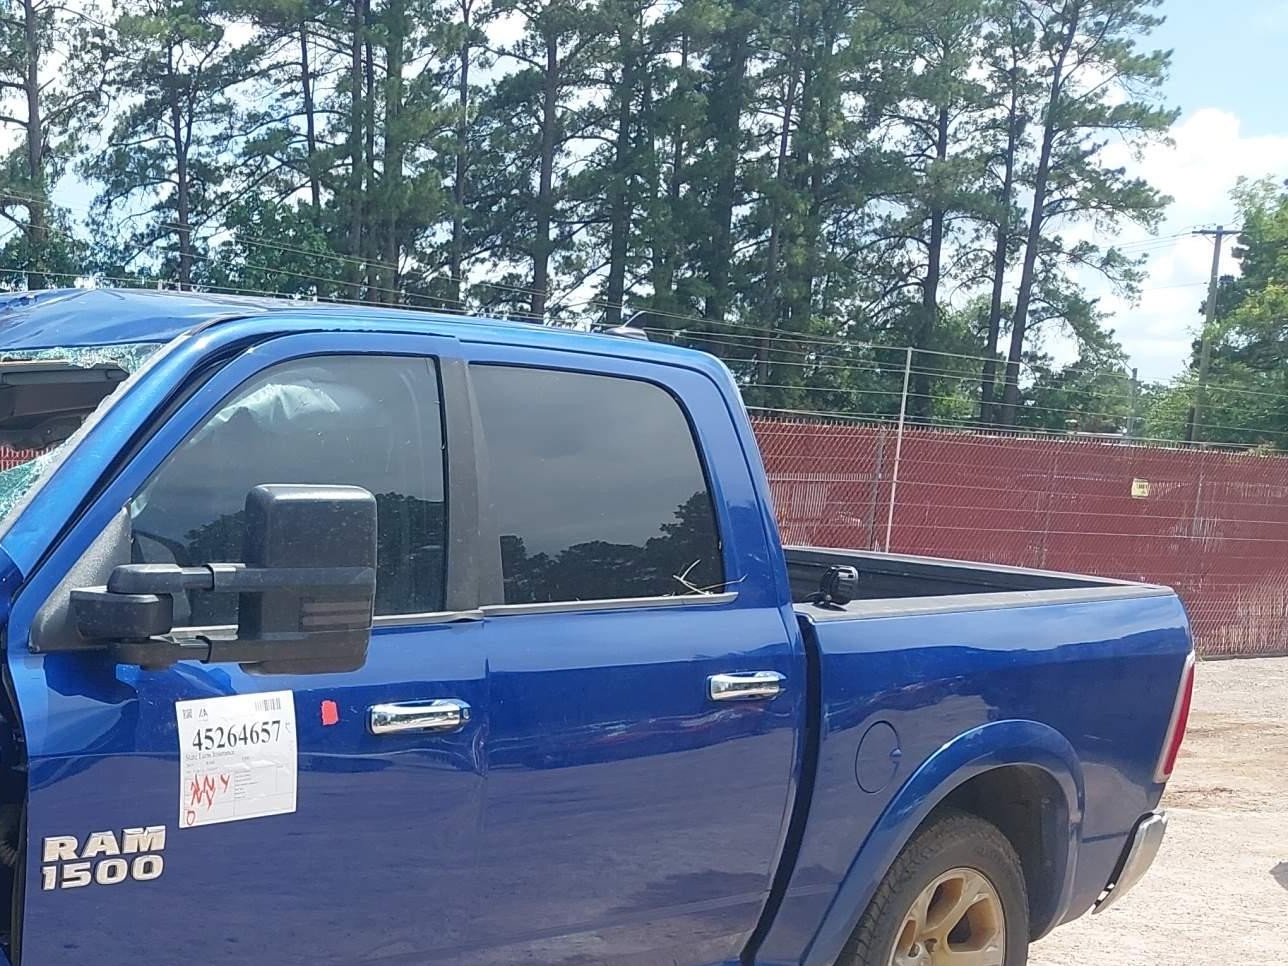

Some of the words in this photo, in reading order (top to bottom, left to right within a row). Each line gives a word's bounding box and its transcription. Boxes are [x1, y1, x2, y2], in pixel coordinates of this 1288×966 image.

[192, 720, 281, 751] 45264657
[43, 825, 167, 863] RAM
[42, 854, 165, 891] 1500
